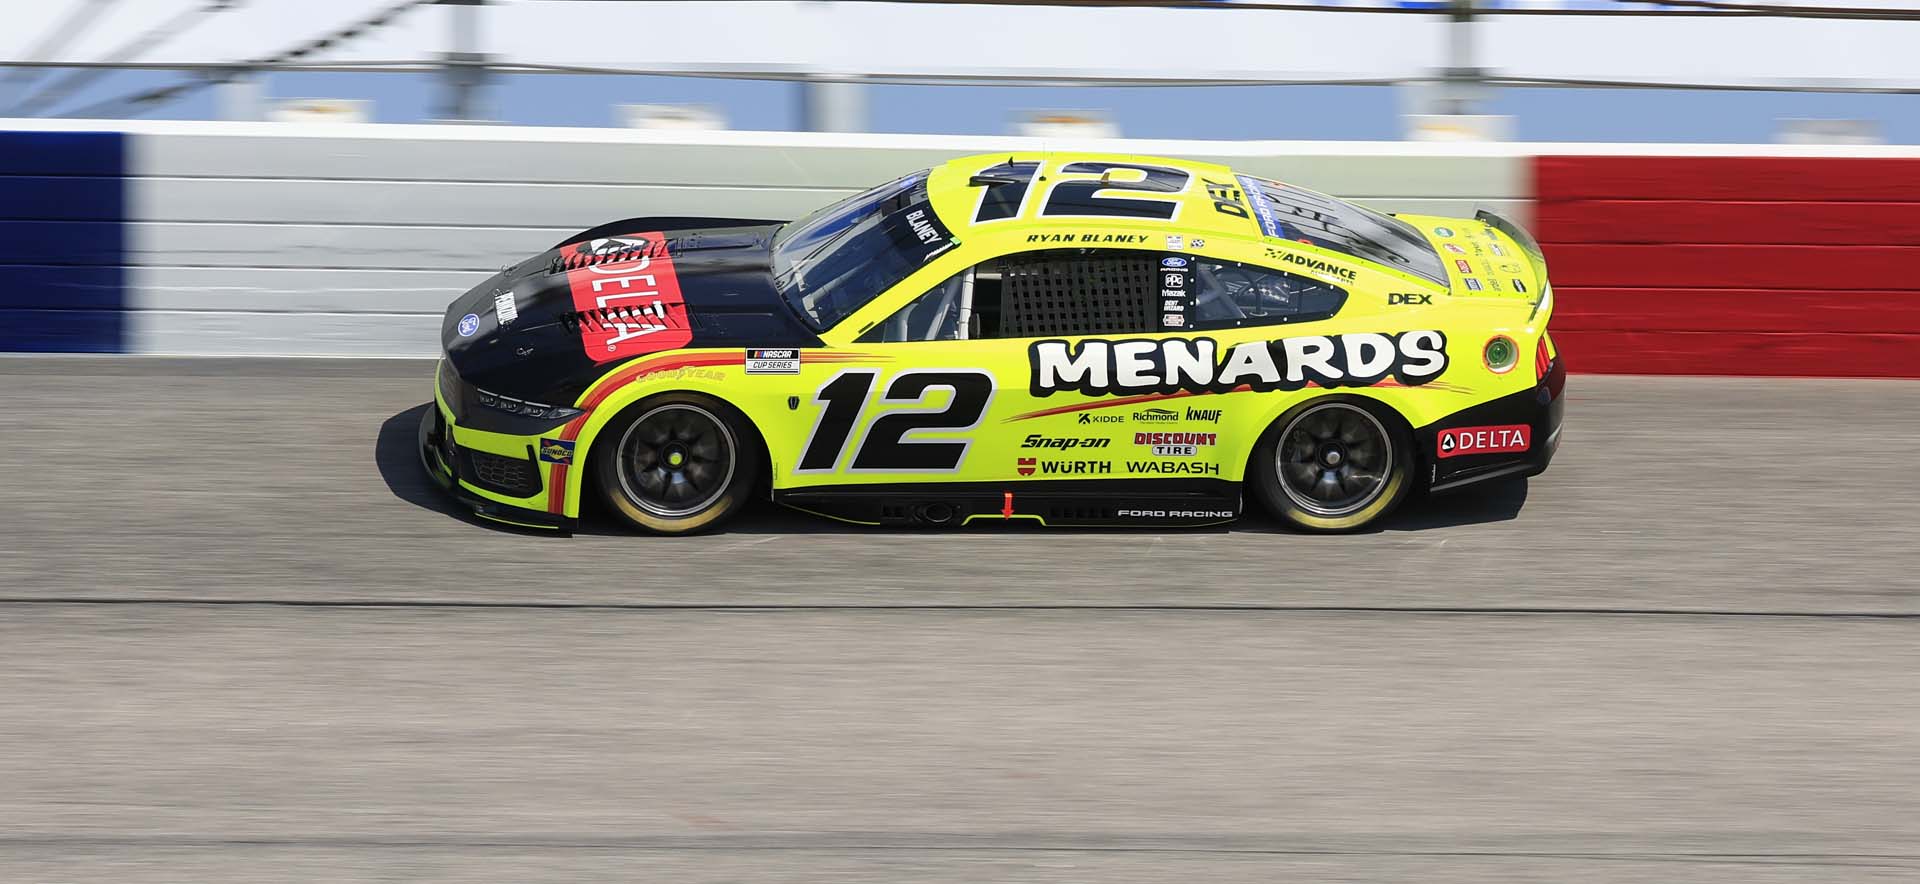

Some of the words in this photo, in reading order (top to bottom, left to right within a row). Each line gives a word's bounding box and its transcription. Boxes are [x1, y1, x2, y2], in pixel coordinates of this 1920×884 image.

[970, 160, 1194, 226] 12
[905, 209, 942, 245] BLANEY
[1026, 234, 1076, 243] RYAN
[1080, 234, 1149, 244] BLANEY
[1283, 253, 1357, 280] ADVANCE
[588, 255, 668, 345] DELTA
[1161, 289, 1187, 297] Mazak
[1388, 293, 1432, 305] DEX
[753, 361, 768, 369] CUP
[768, 361, 793, 369] SERIES
[1031, 330, 1449, 395] MENARDS
[795, 369, 997, 472] 12
[1093, 415, 1125, 424] KIDDE
[1132, 411, 1179, 421] Richmond
[1185, 406, 1223, 425] KNAUF
[1020, 434, 1111, 451] Snap-on
[1134, 432, 1217, 446] DISCOUNT
[1459, 430, 1526, 449] DELTA
[542, 446, 573, 457] SUNOCO
[1156, 446, 1193, 455] TIRE
[1041, 460, 1112, 474] WÜRTH
[1126, 461, 1220, 475] WABASH
[1169, 510, 1233, 518] RACING
